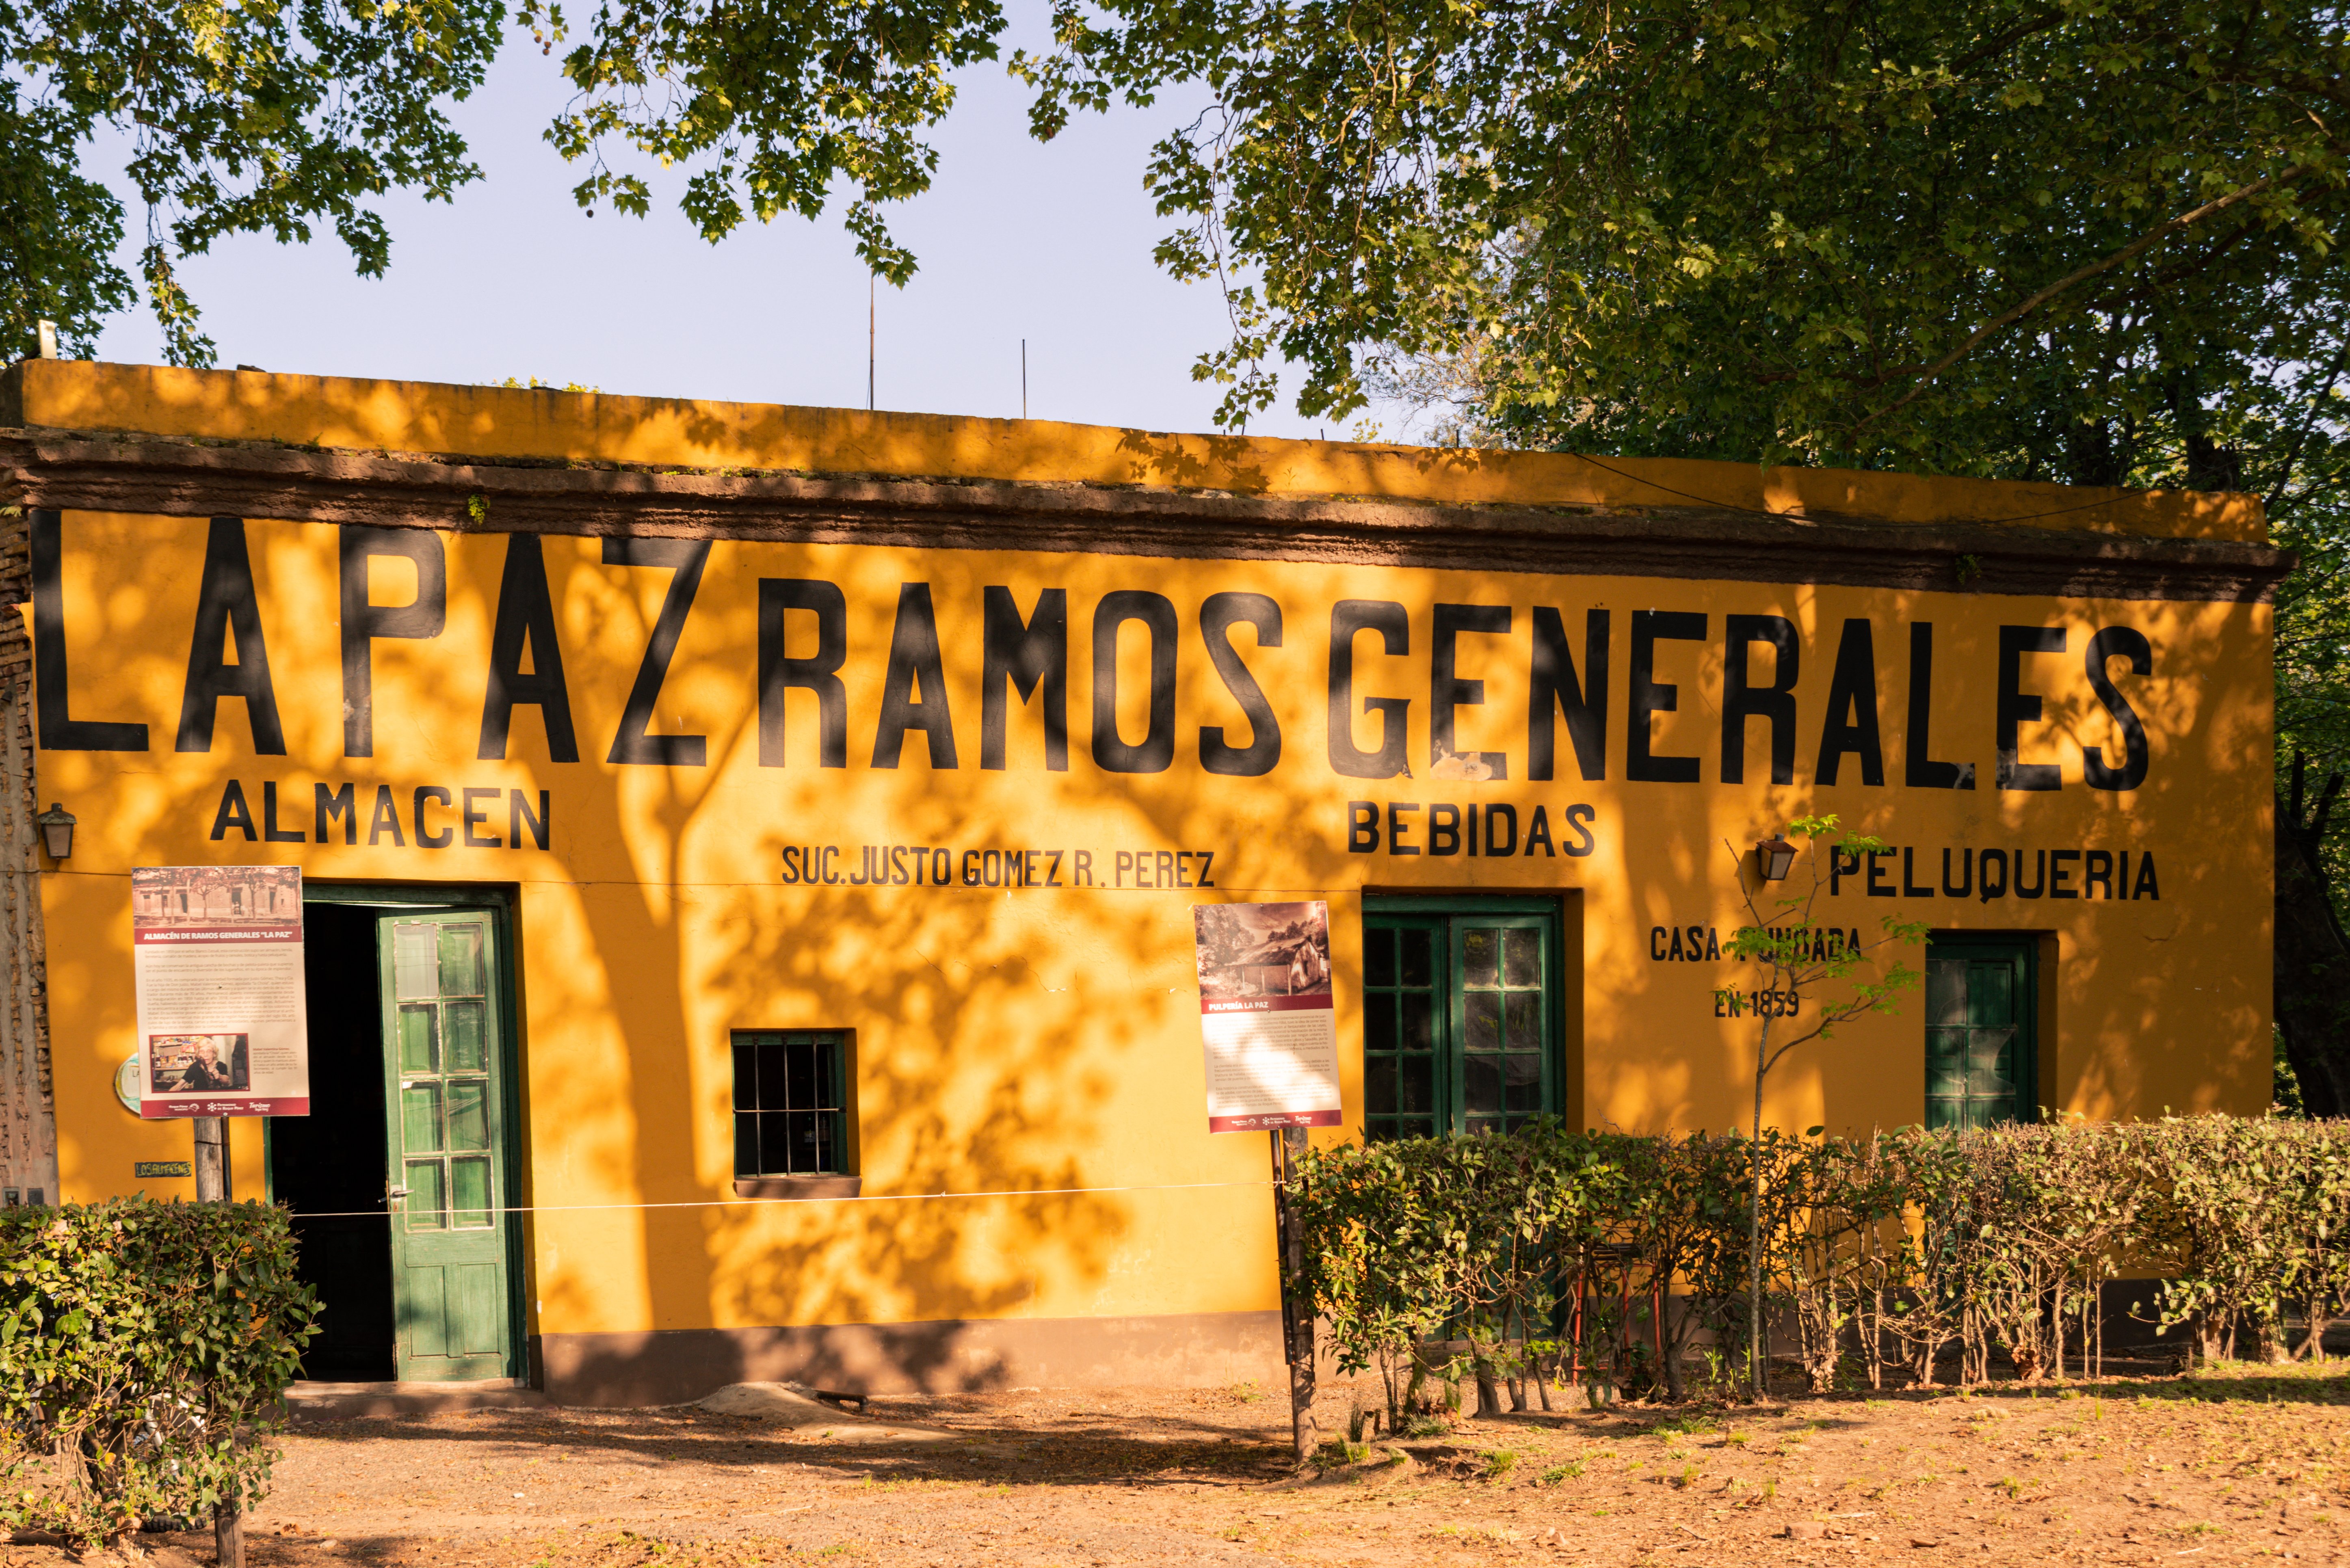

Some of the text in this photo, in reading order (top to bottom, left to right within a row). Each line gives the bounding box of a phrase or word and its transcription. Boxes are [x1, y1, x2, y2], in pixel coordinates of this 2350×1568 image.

[31, 509, 2152, 792] LA PAZ RAMOS GENERALES
[210, 780, 550, 851] ALMACEN
[1348, 801, 1596, 858] BEBIDAS
[963, 849, 1064, 887] GOMEZ
[1116, 851, 1215, 888] PEREZ
[1831, 845, 2160, 904] PELUQUERIA
[144, 932, 180, 940] ALMACÉN
[1651, 926, 1720, 962] CASA
[1209, 1001, 1243, 1010] PULPERÍA
[1714, 991, 1799, 1017] EN 1859
